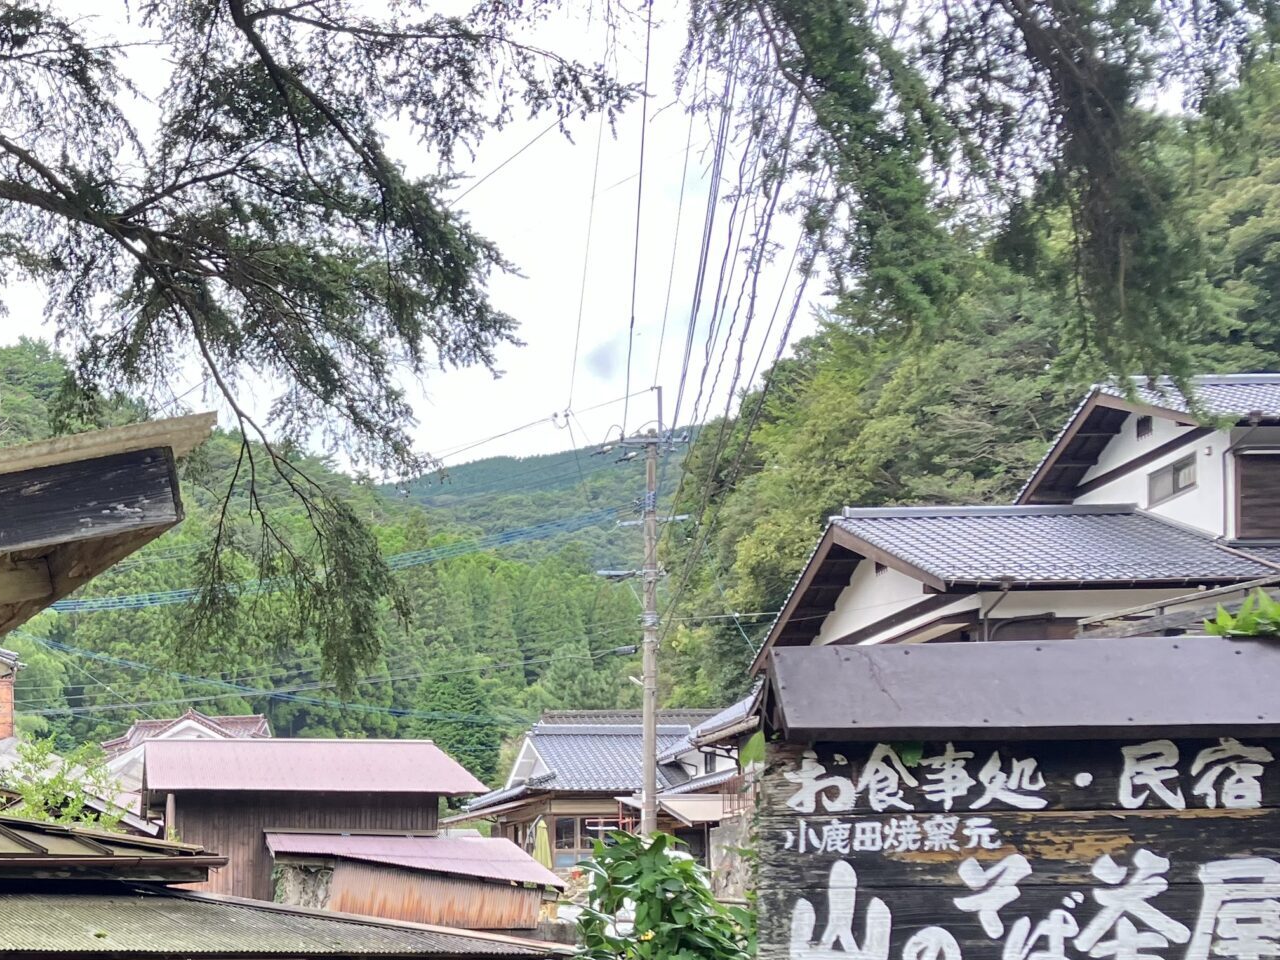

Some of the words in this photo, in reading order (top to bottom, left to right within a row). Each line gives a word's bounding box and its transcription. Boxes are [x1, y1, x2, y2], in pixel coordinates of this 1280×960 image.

[784, 814, 1002, 853] 小鹿田焼窯元
